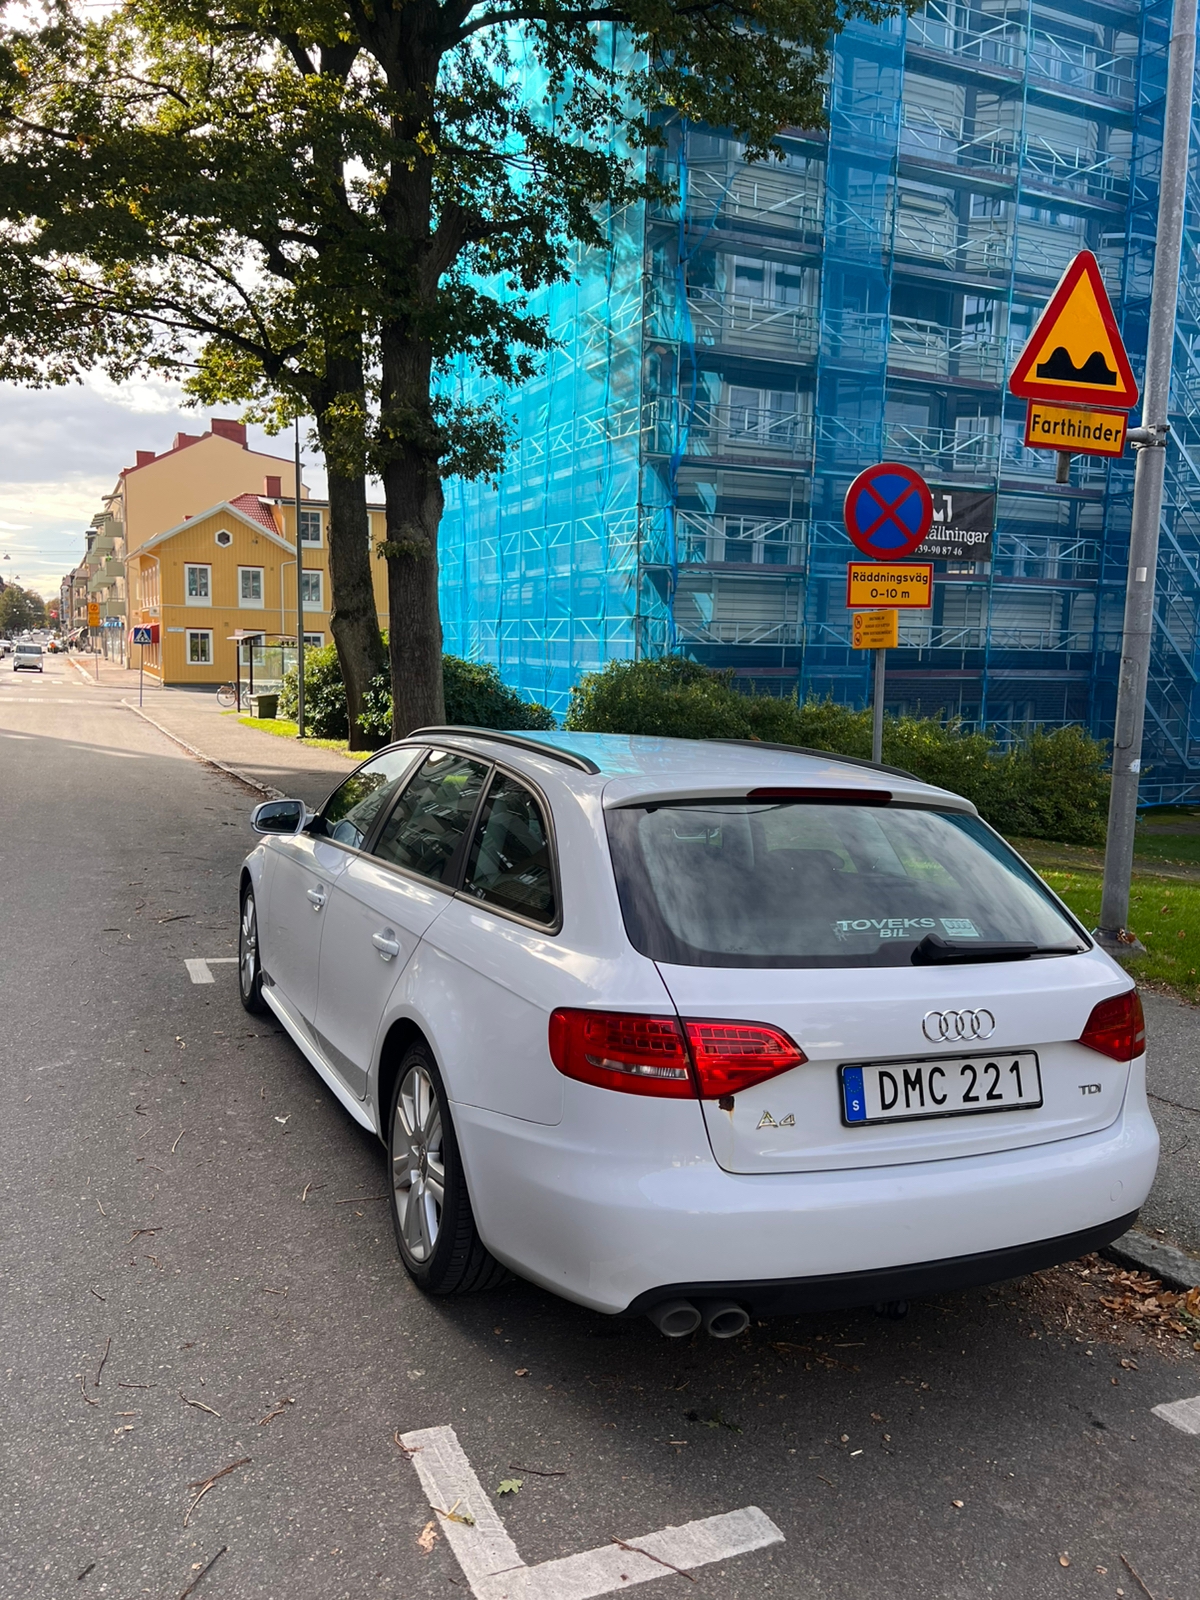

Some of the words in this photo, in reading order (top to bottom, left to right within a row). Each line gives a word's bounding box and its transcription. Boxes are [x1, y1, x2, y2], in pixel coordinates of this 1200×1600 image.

[1031, 413, 1122, 443] Farthinder
[852, 571, 928, 585] Räddningsväg
[870, 588, 898, 599] 0-10
[901, 591, 910, 599] m
[837, 917, 936, 932] TOVEKS
[879, 928, 910, 938] BIL
[878, 1067, 948, 1111] DMC
[960, 1060, 1023, 1103] 221
[1077, 1082, 1102, 1095] TDI
[852, 1100, 860, 1111] S
[756, 1109, 796, 1130] A4
